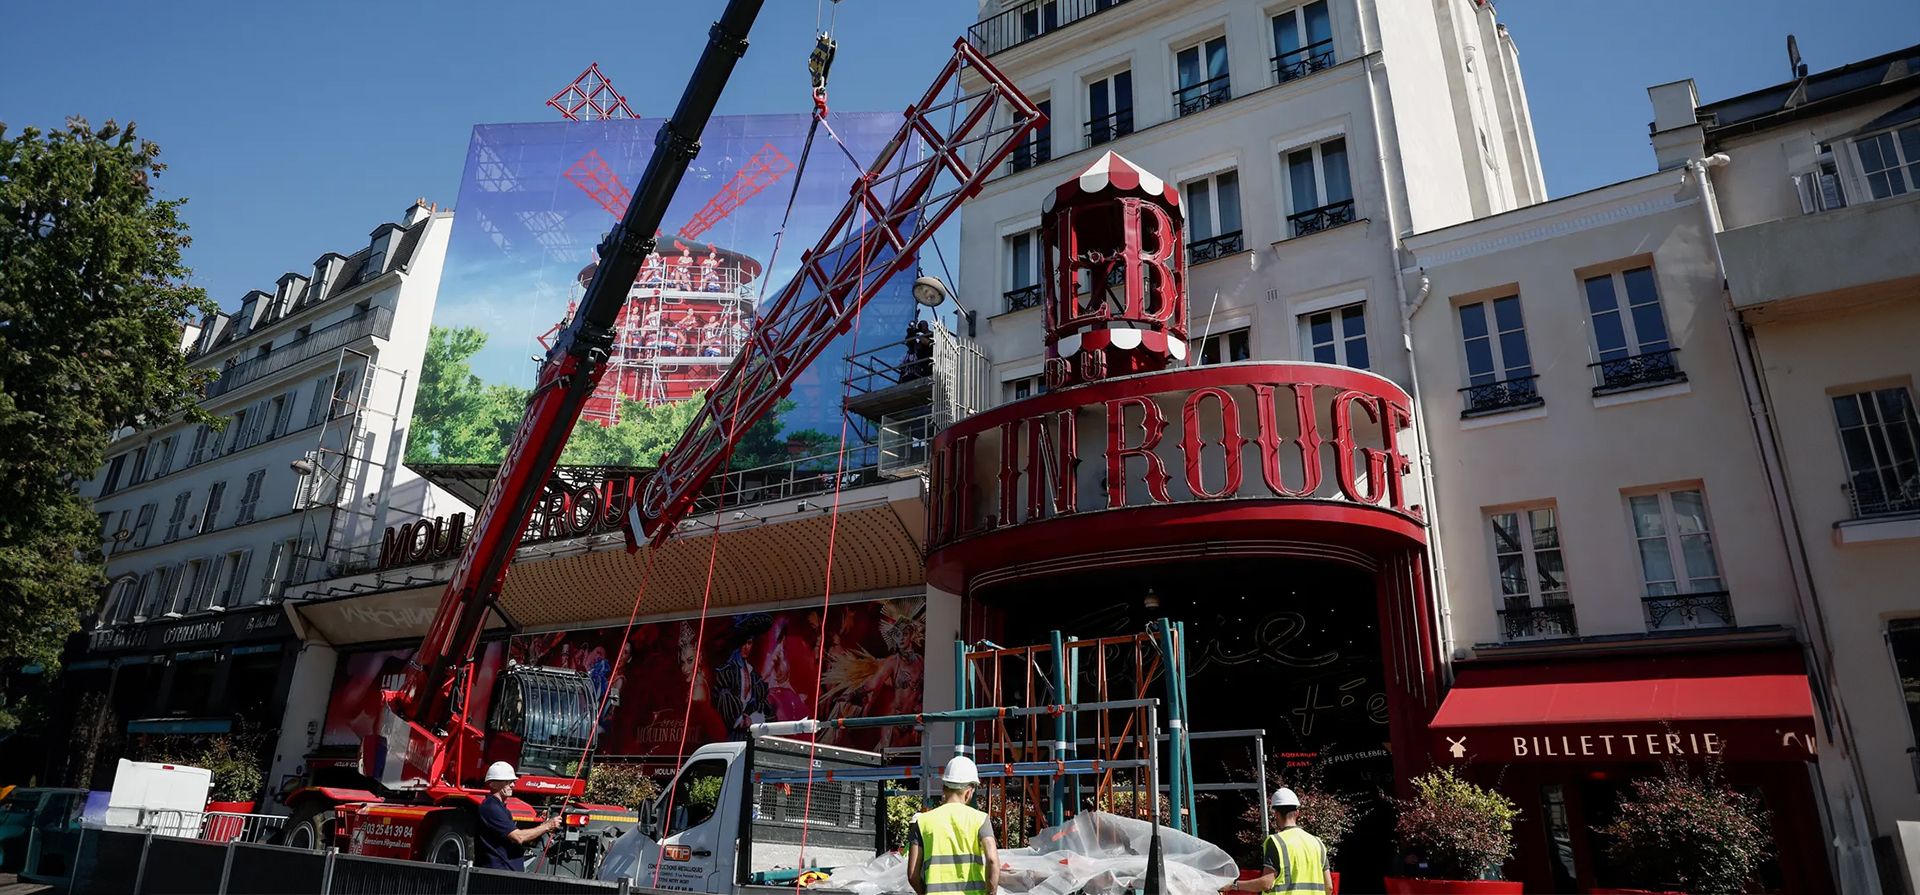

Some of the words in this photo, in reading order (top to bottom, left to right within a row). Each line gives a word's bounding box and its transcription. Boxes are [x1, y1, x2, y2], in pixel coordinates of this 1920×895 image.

[1105, 382, 1423, 519] ROUGE
[378, 512, 466, 569] MOUL
[340, 606, 438, 628] MACHIN
[1513, 732, 1722, 757] BILLETTERIE
[1335, 753, 1354, 763] PLUS
[366, 823, 375, 835] 03
[375, 824, 384, 836] 25
[384, 825, 393, 837] 41
[393, 825, 403, 837] 39
[403, 826, 413, 838] 84
